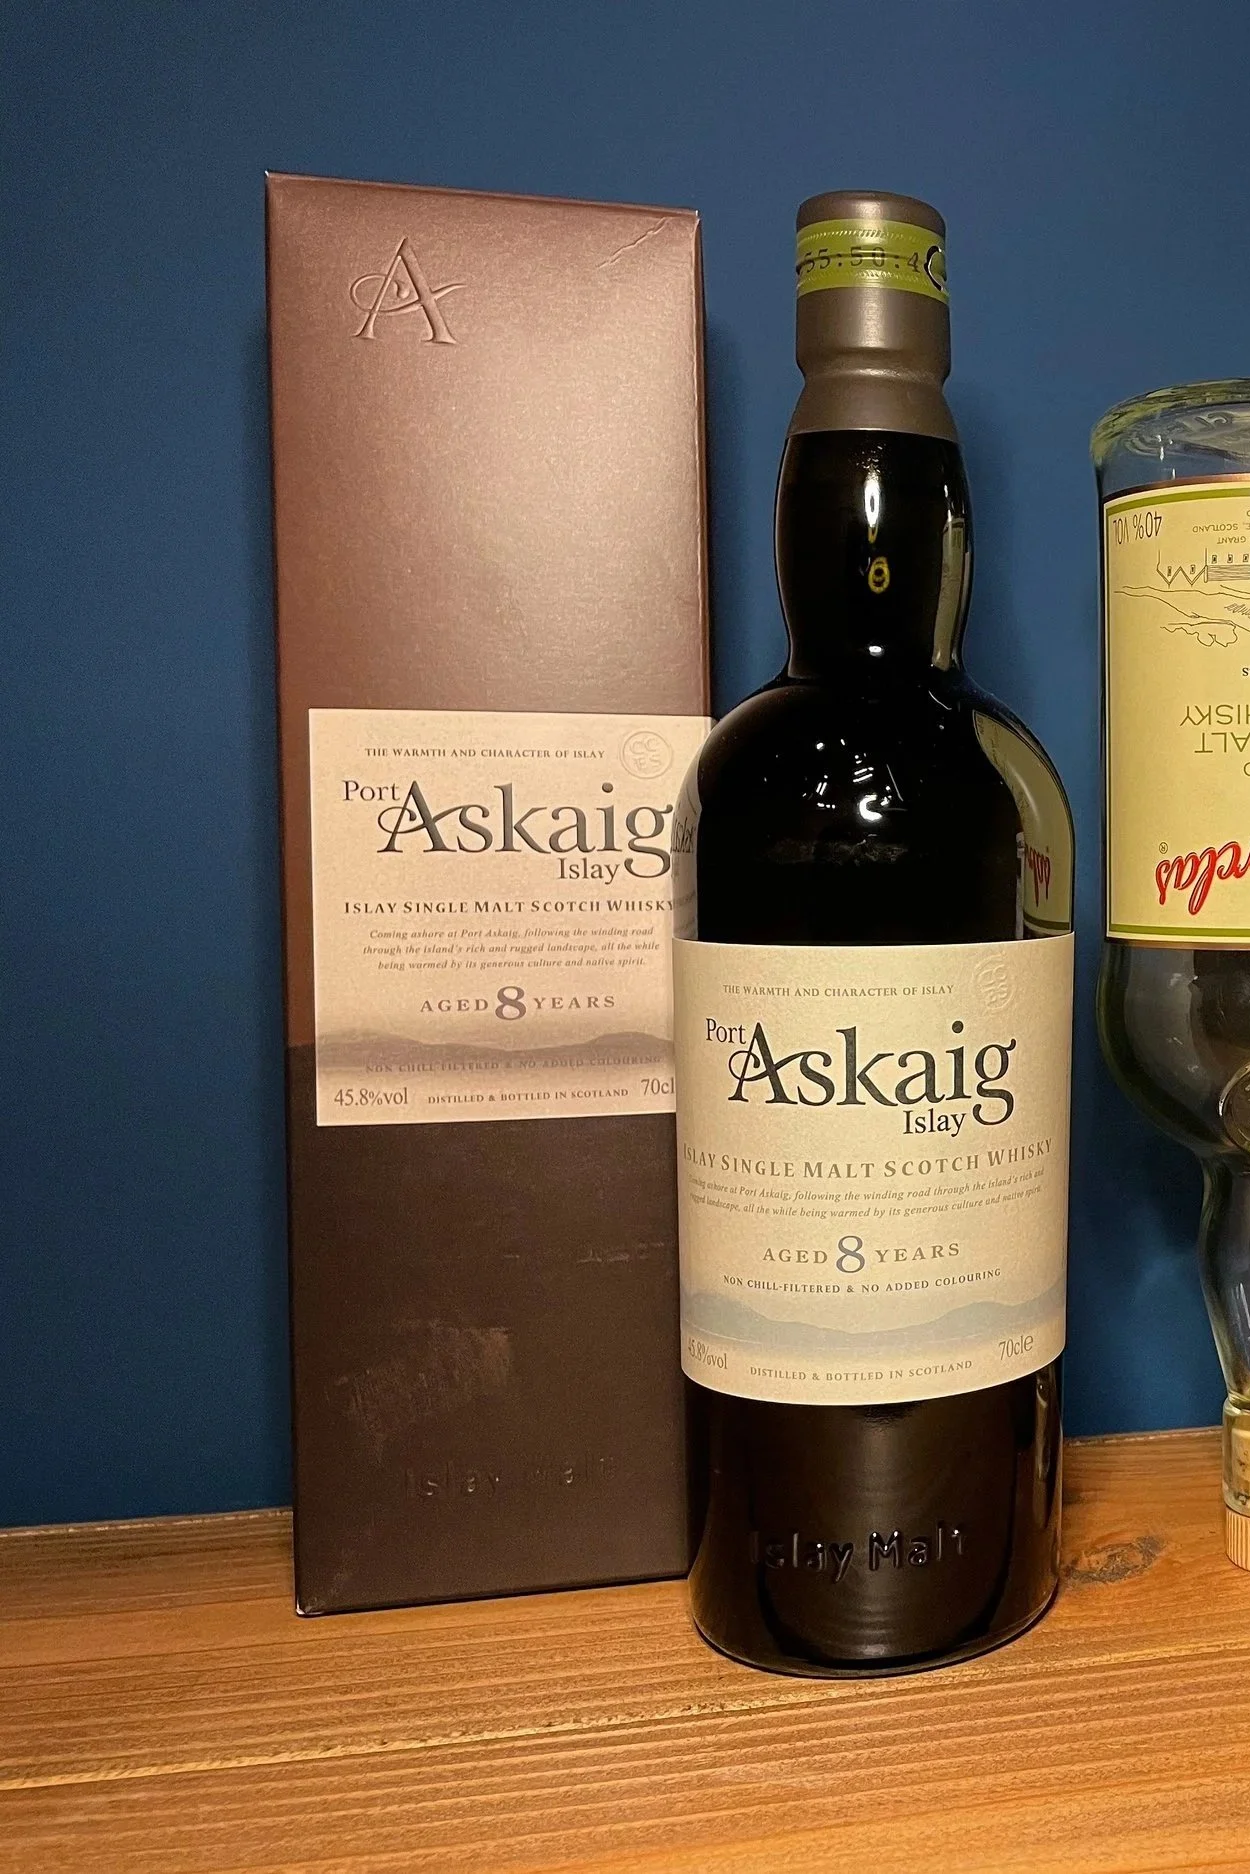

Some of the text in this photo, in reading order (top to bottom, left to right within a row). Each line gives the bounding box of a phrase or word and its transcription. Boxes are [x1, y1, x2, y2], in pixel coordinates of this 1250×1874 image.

[350, 237, 468, 345] A
[1113, 510, 1162, 546] 40% VOL
[1192, 522, 1239, 533] SCOTLAND
[1216, 534, 1246, 545] GRANT
[365, 748, 605, 759] THE WARMTH AND CHARACTER OF ISLAY
[342, 780, 400, 801] Port
[377, 780, 673, 879] Askaig
[558, 857, 620, 884] Islay
[344, 899, 673, 915] ISLAY SINGLE MALT SCOTCH WHISKY
[420, 985, 616, 1020] AGED 8 YEARS
[723, 984, 954, 997] THE WARMTH AND CHARACTER OF ISLAY
[706, 1018, 1017, 1126] Port Askaig
[334, 1087, 408, 1107] 45.8%vol
[641, 1078, 675, 1096] 70cl
[902, 1110, 966, 1137] Islay
[683, 1138, 1053, 1179] ISLAY SINGLE MALT SCOTCH WHISKY
[763, 1236, 960, 1274] AGED 8 YEARS
[724, 1268, 1001, 1293] NON CHILL-FILTERED & NO ADDED COLOURING
[750, 1360, 972, 1382] DISTILLED & BOTTLED IN SCOTLAND
[750, 1520, 964, 1583] Islay Malt
